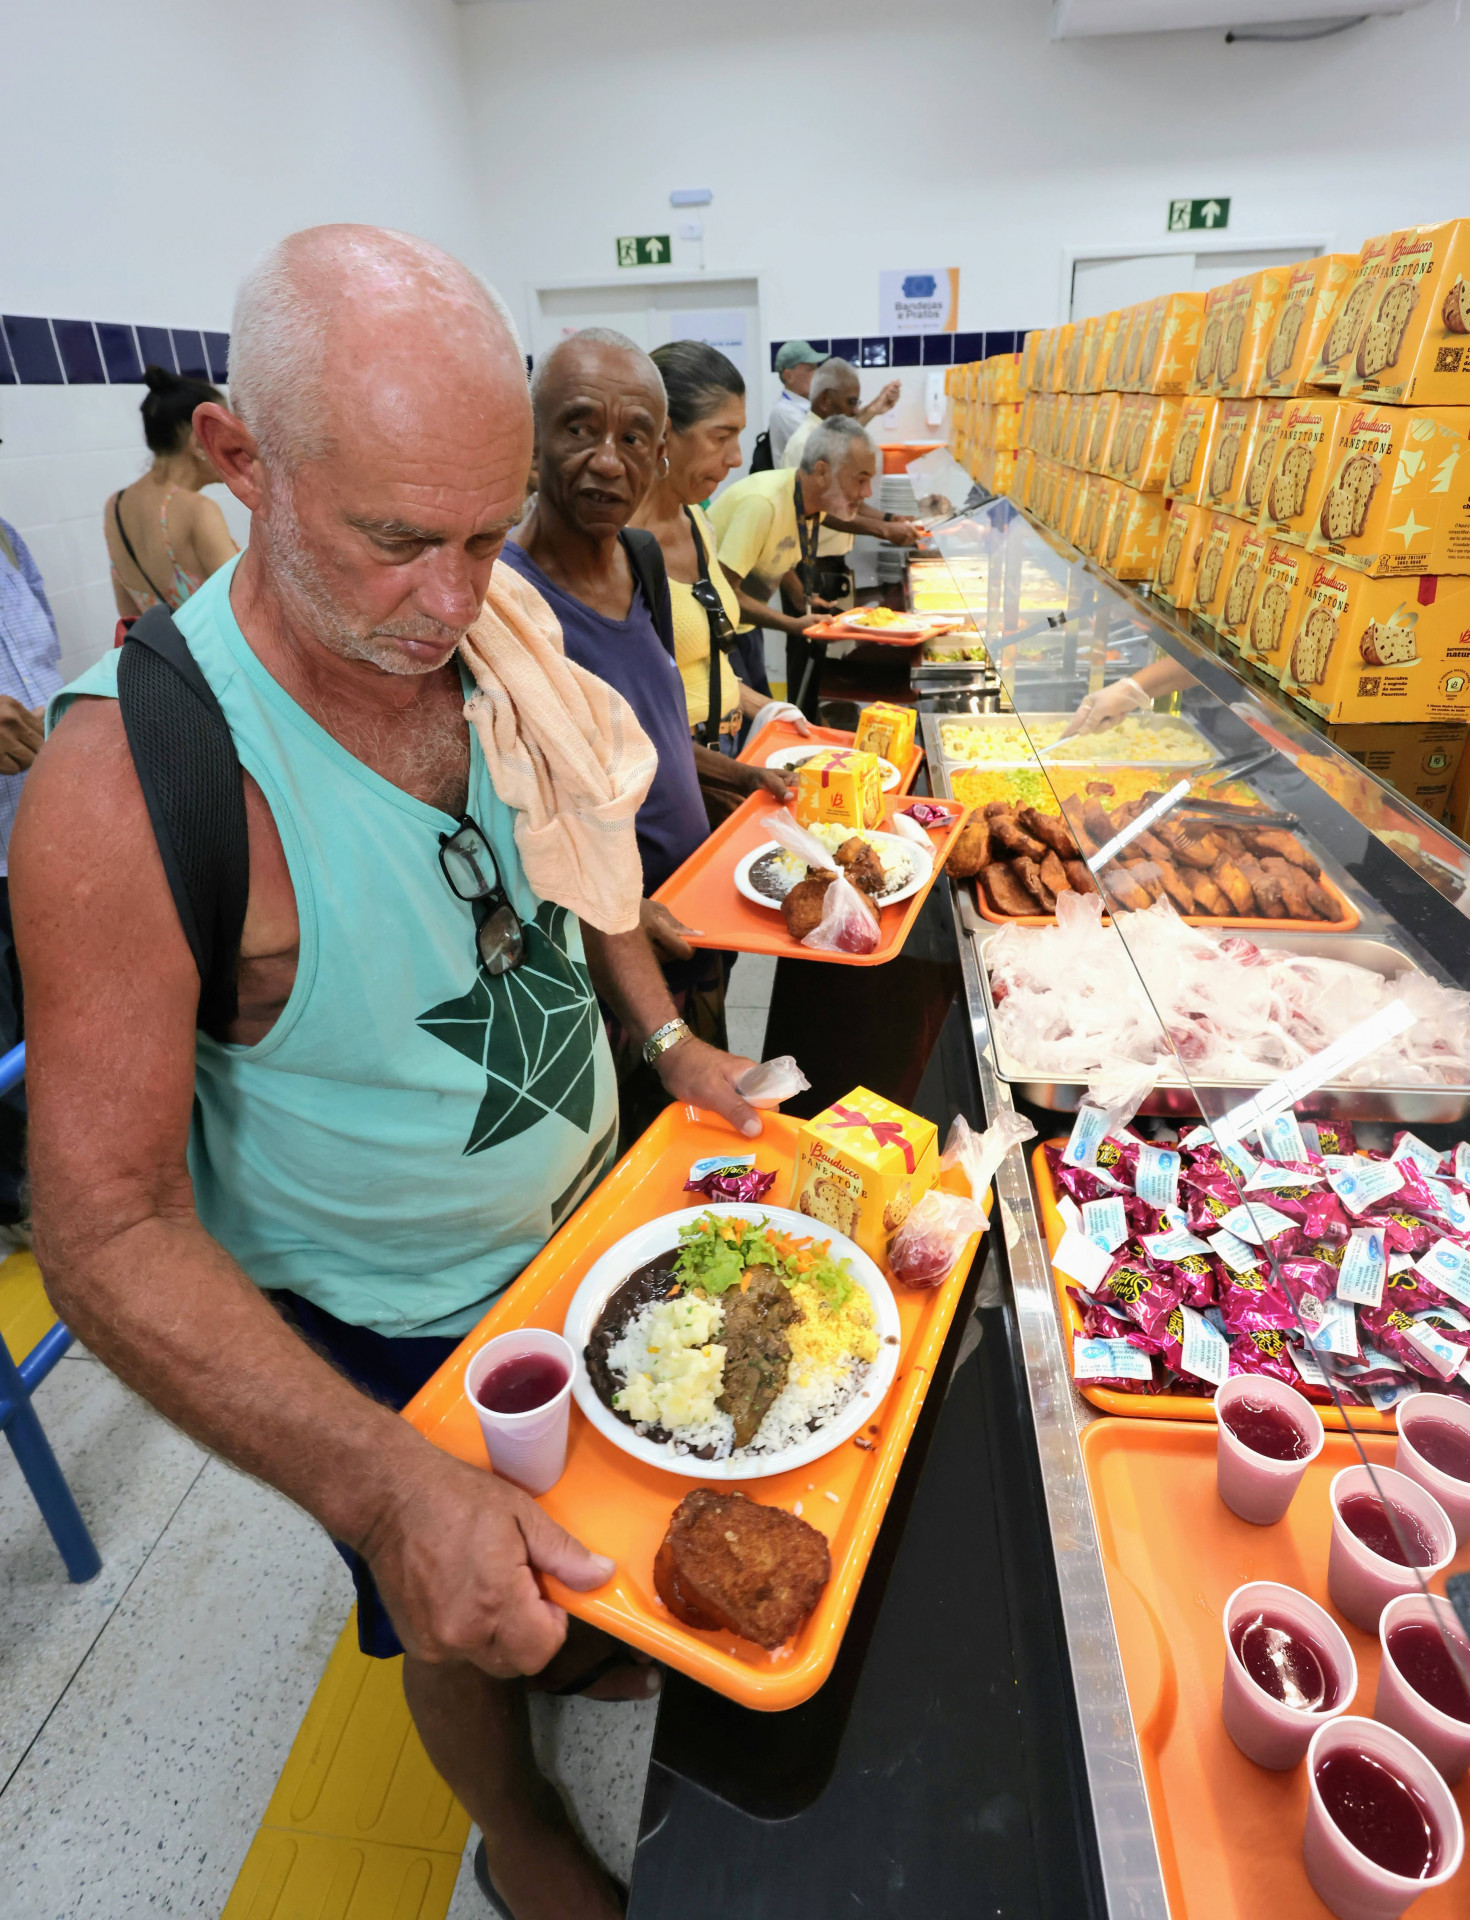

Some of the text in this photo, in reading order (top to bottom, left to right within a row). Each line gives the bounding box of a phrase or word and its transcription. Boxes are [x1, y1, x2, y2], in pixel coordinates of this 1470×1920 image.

[1361, 242, 1386, 265] Baud
[1390, 234, 1433, 264] Bauducco
[1351, 264, 1381, 279] PANETT
[1379, 261, 1434, 278] PANETTONE
[895, 301, 943, 311] Bandejas
[906, 310, 940, 319] Pratos
[1287, 407, 1323, 428] Bauducco
[1349, 407, 1392, 435] Bauducco
[1280, 429, 1325, 443] PANETTONE
[1339, 436, 1393, 455] PANETTONE
[1236, 547, 1262, 564] PANETTON
[1268, 544, 1298, 568] Bauducco
[1261, 564, 1300, 587] PANETTONE
[1312, 564, 1348, 592] Bauducco
[1304, 586, 1350, 614] PANETTONE
[810, 1141, 860, 1180] Bauducco
[801, 1152, 868, 1199] PANETTONE
[1110, 1277, 1152, 1304] Sonho
